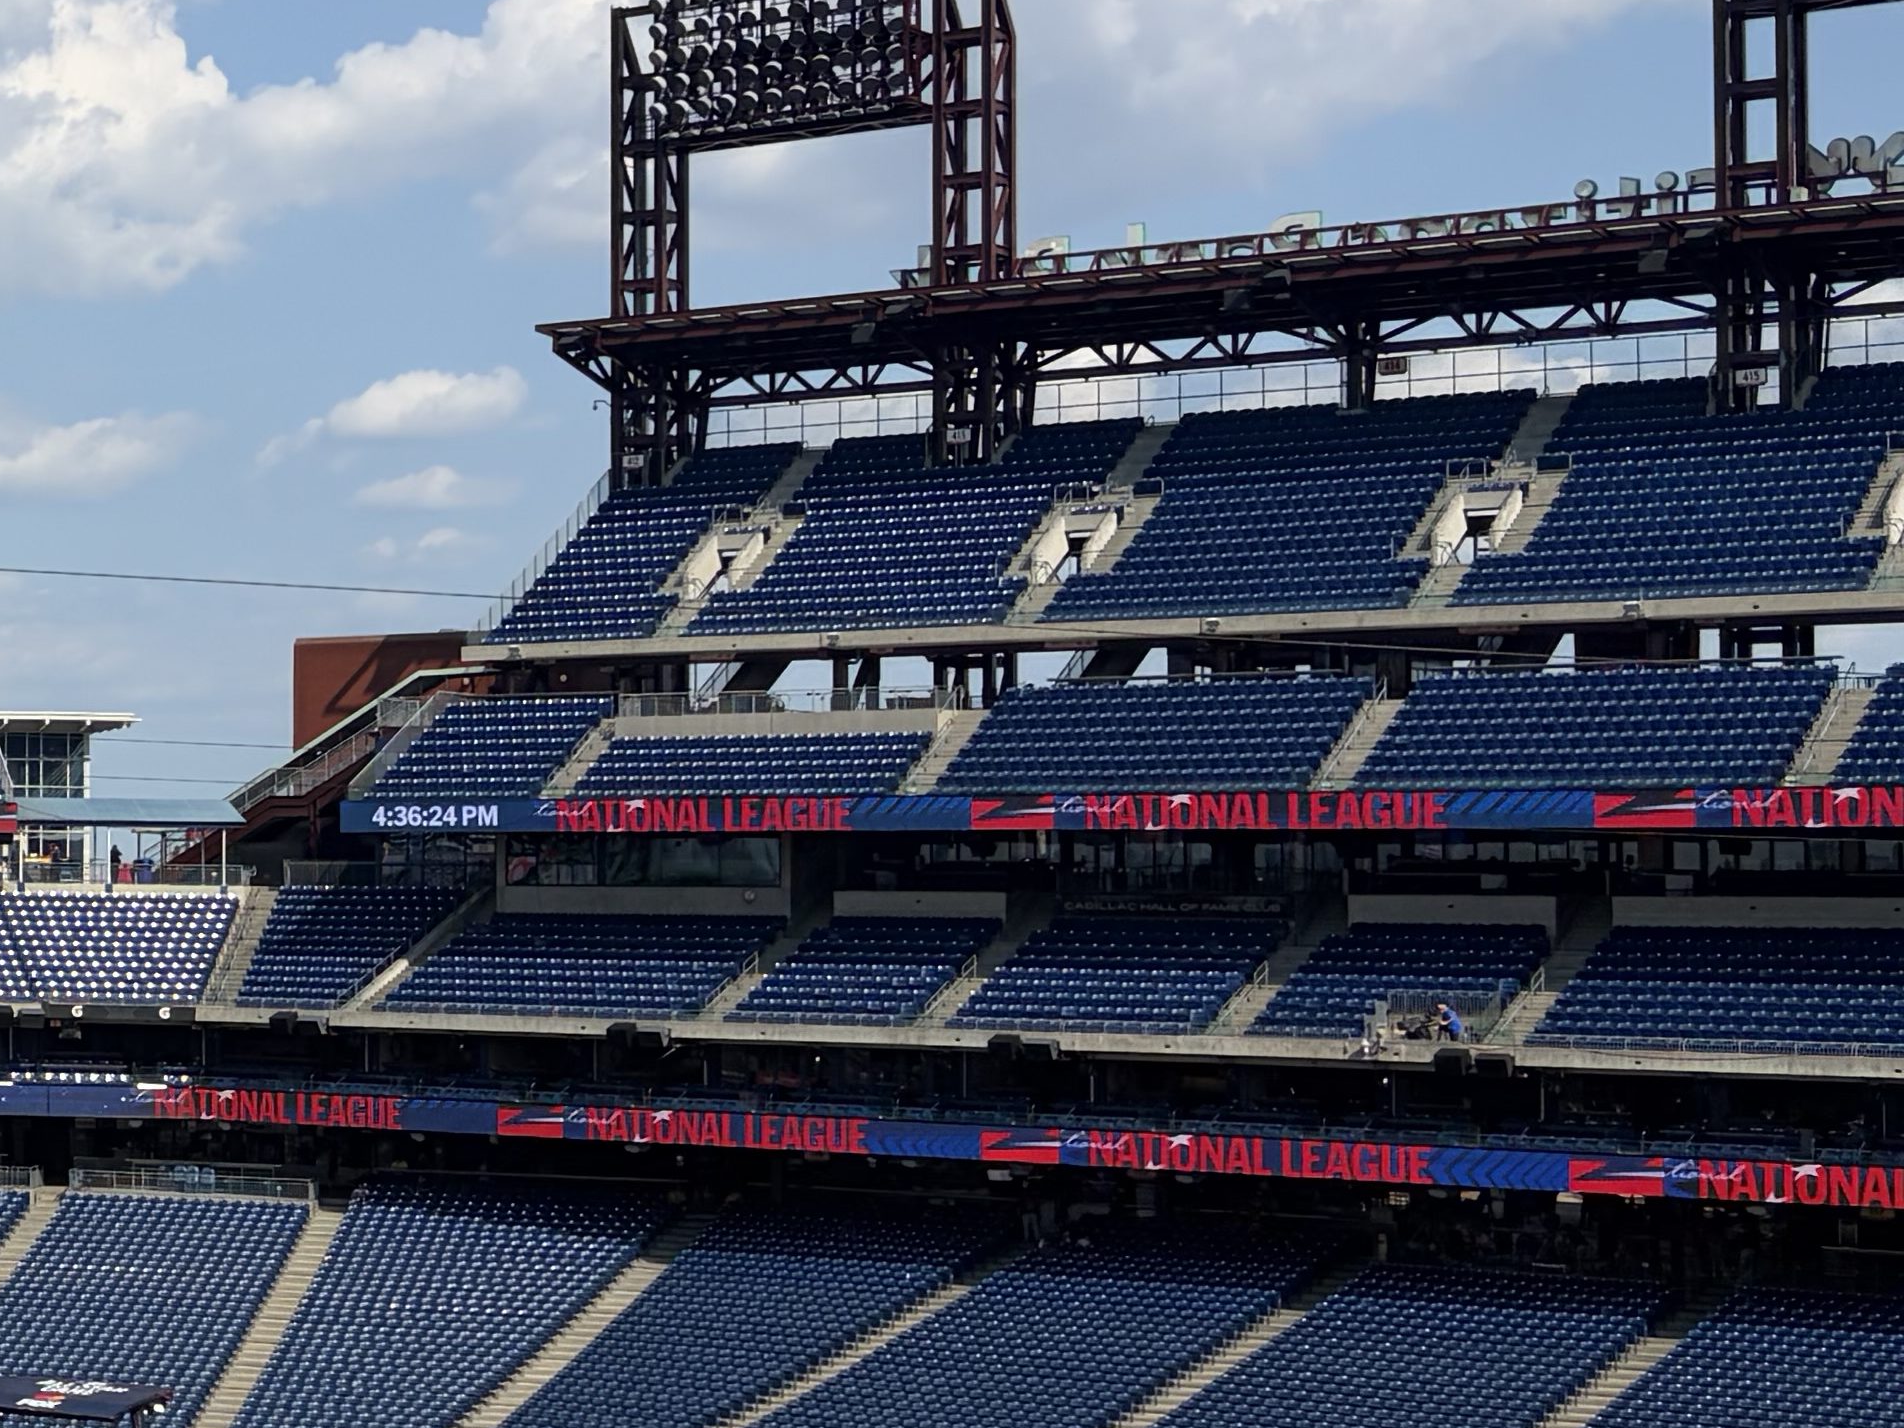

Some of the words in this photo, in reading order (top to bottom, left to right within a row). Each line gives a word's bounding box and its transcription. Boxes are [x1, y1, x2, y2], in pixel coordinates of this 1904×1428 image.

[371, 805, 458, 828] 4:36:24
[462, 805, 498, 828] PM
[555, 797, 716, 832] NATIONAL
[722, 797, 852, 832] LEAGUE
[1085, 792, 1279, 830] NATIONAL
[1287, 791, 1450, 830] LEAGUE
[1064, 901, 1136, 911] CADILLAC
[1139, 902, 1177, 912] HALL
[1179, 902, 1198, 912] OF
[1201, 902, 1239, 912] FAME
[1242, 902, 1281, 913] CLUB
[153, 1088, 291, 1124] NATIONAL
[296, 1092, 402, 1130] LEAGUE
[586, 1107, 737, 1148] NATIONAL
[742, 1113, 869, 1154] LEAGUE
[1088, 1130, 1272, 1176] NATIONAL
[1280, 1137, 1434, 1185] LEAGUE
